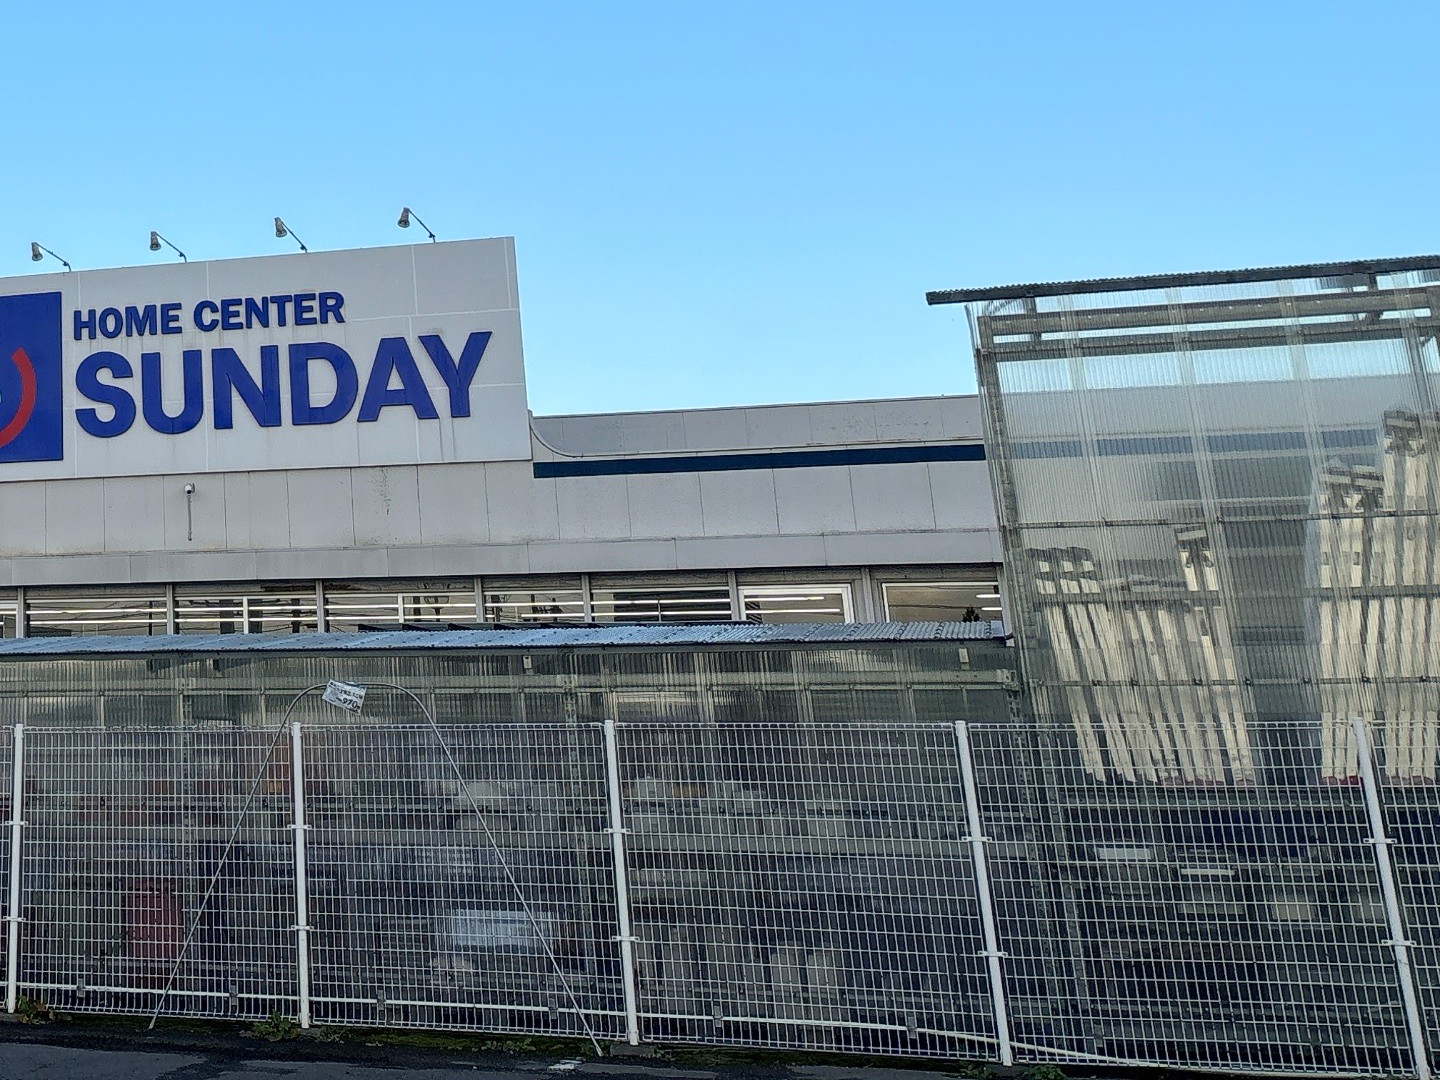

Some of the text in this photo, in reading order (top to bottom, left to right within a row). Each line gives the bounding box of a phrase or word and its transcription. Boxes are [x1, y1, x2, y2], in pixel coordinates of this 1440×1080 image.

[73, 291, 346, 341] HOME CENTER
[74, 330, 494, 438] SUNDAY
